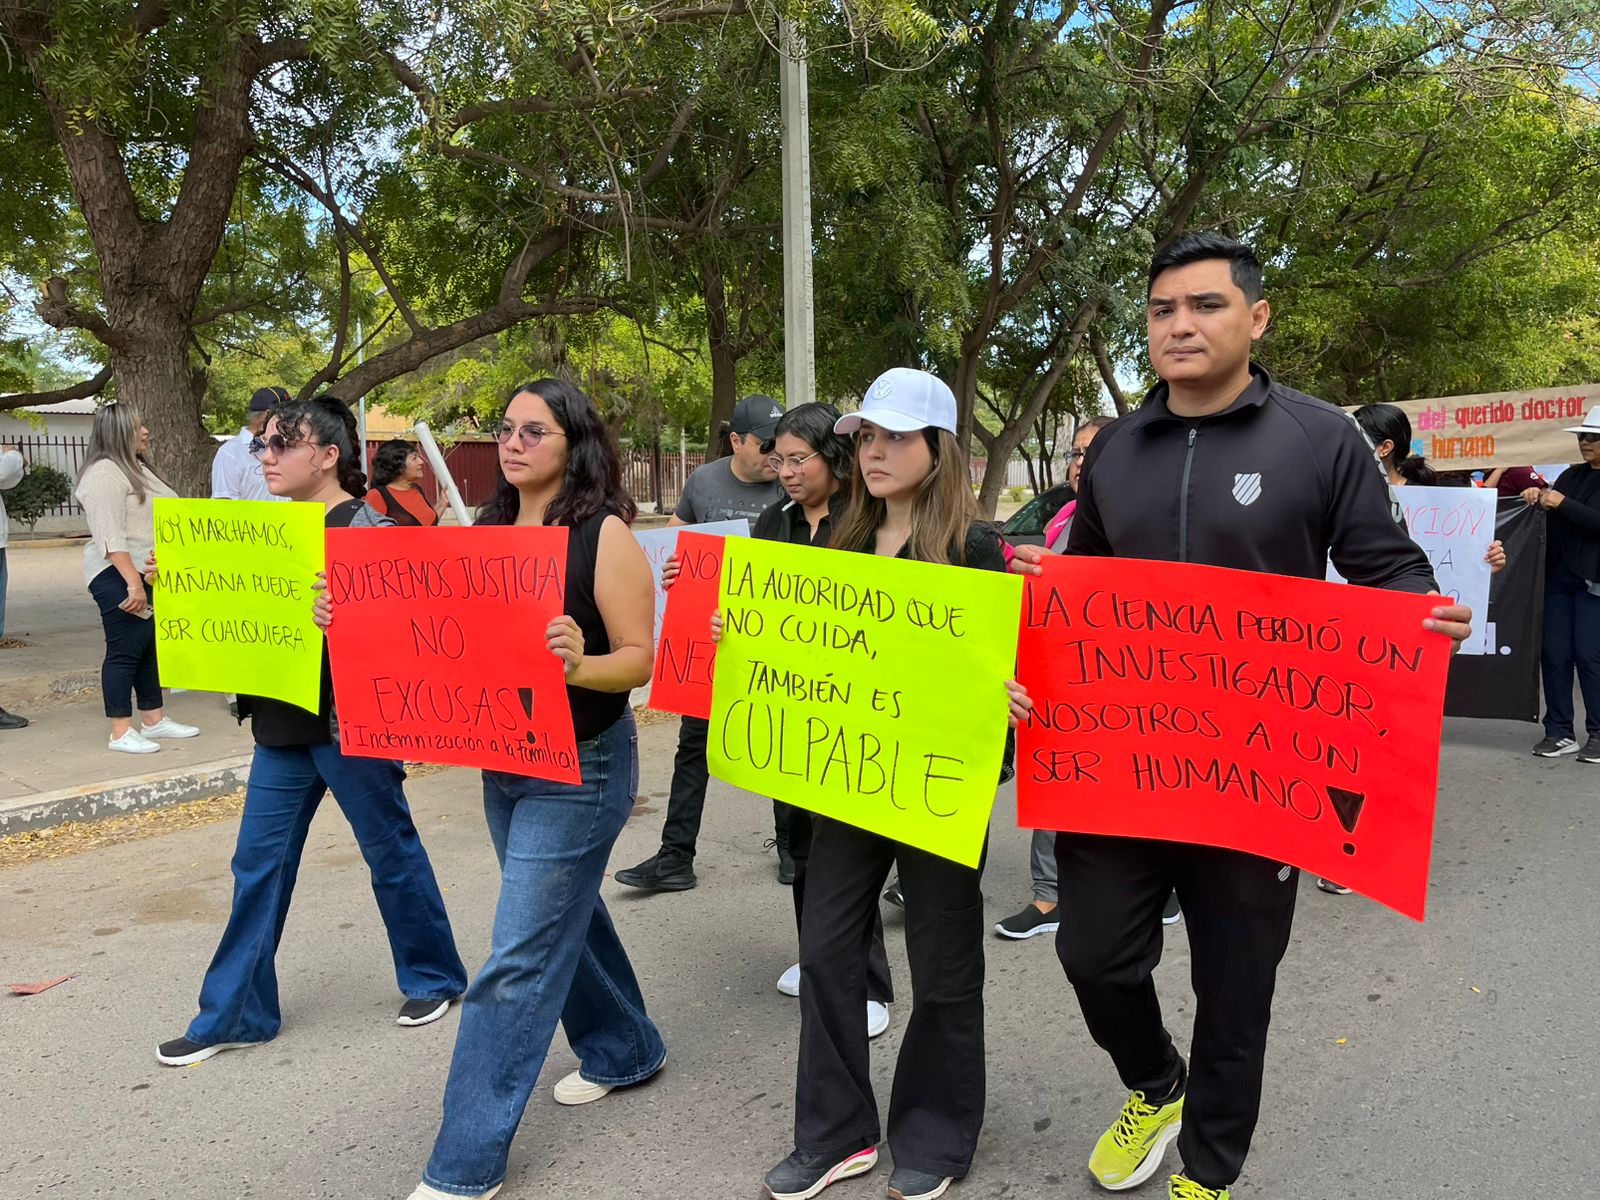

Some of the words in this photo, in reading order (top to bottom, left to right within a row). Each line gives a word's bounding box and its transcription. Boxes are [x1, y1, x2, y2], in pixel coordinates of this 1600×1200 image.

[1455, 399, 1514, 430] querido
[1432, 434, 1495, 460] humano
[155, 513, 185, 546] HOY
[189, 517, 292, 551] MARCHAMOS,
[157, 566, 246, 593] MAÑANA
[252, 573, 302, 600] PUEDE
[330, 558, 453, 605] QUEREMOS
[455, 556, 563, 604] JUSTICIA
[678, 549, 719, 580] NO
[727, 557, 754, 599] LA
[762, 568, 895, 622] AUTORIDAD
[906, 597, 965, 637] QUE
[159, 617, 193, 641] SER
[201, 618, 306, 651] CUALQUIERA
[410, 615, 465, 659] NO
[726, 607, 763, 637] NO
[780, 614, 877, 660] CUIDA,
[1027, 581, 1071, 628] LA
[1083, 590, 1224, 641] CIENCIA
[1357, 635, 1423, 673] UN
[748, 660, 851, 704] TAMBIÉN
[872, 688, 902, 719] ES
[722, 699, 964, 817] CULPABLE
[1026, 698, 1222, 739] NOSOTROS
[1245, 721, 1273, 752] A
[1293, 732, 1360, 774] UN
[1032, 748, 1101, 783] SER
